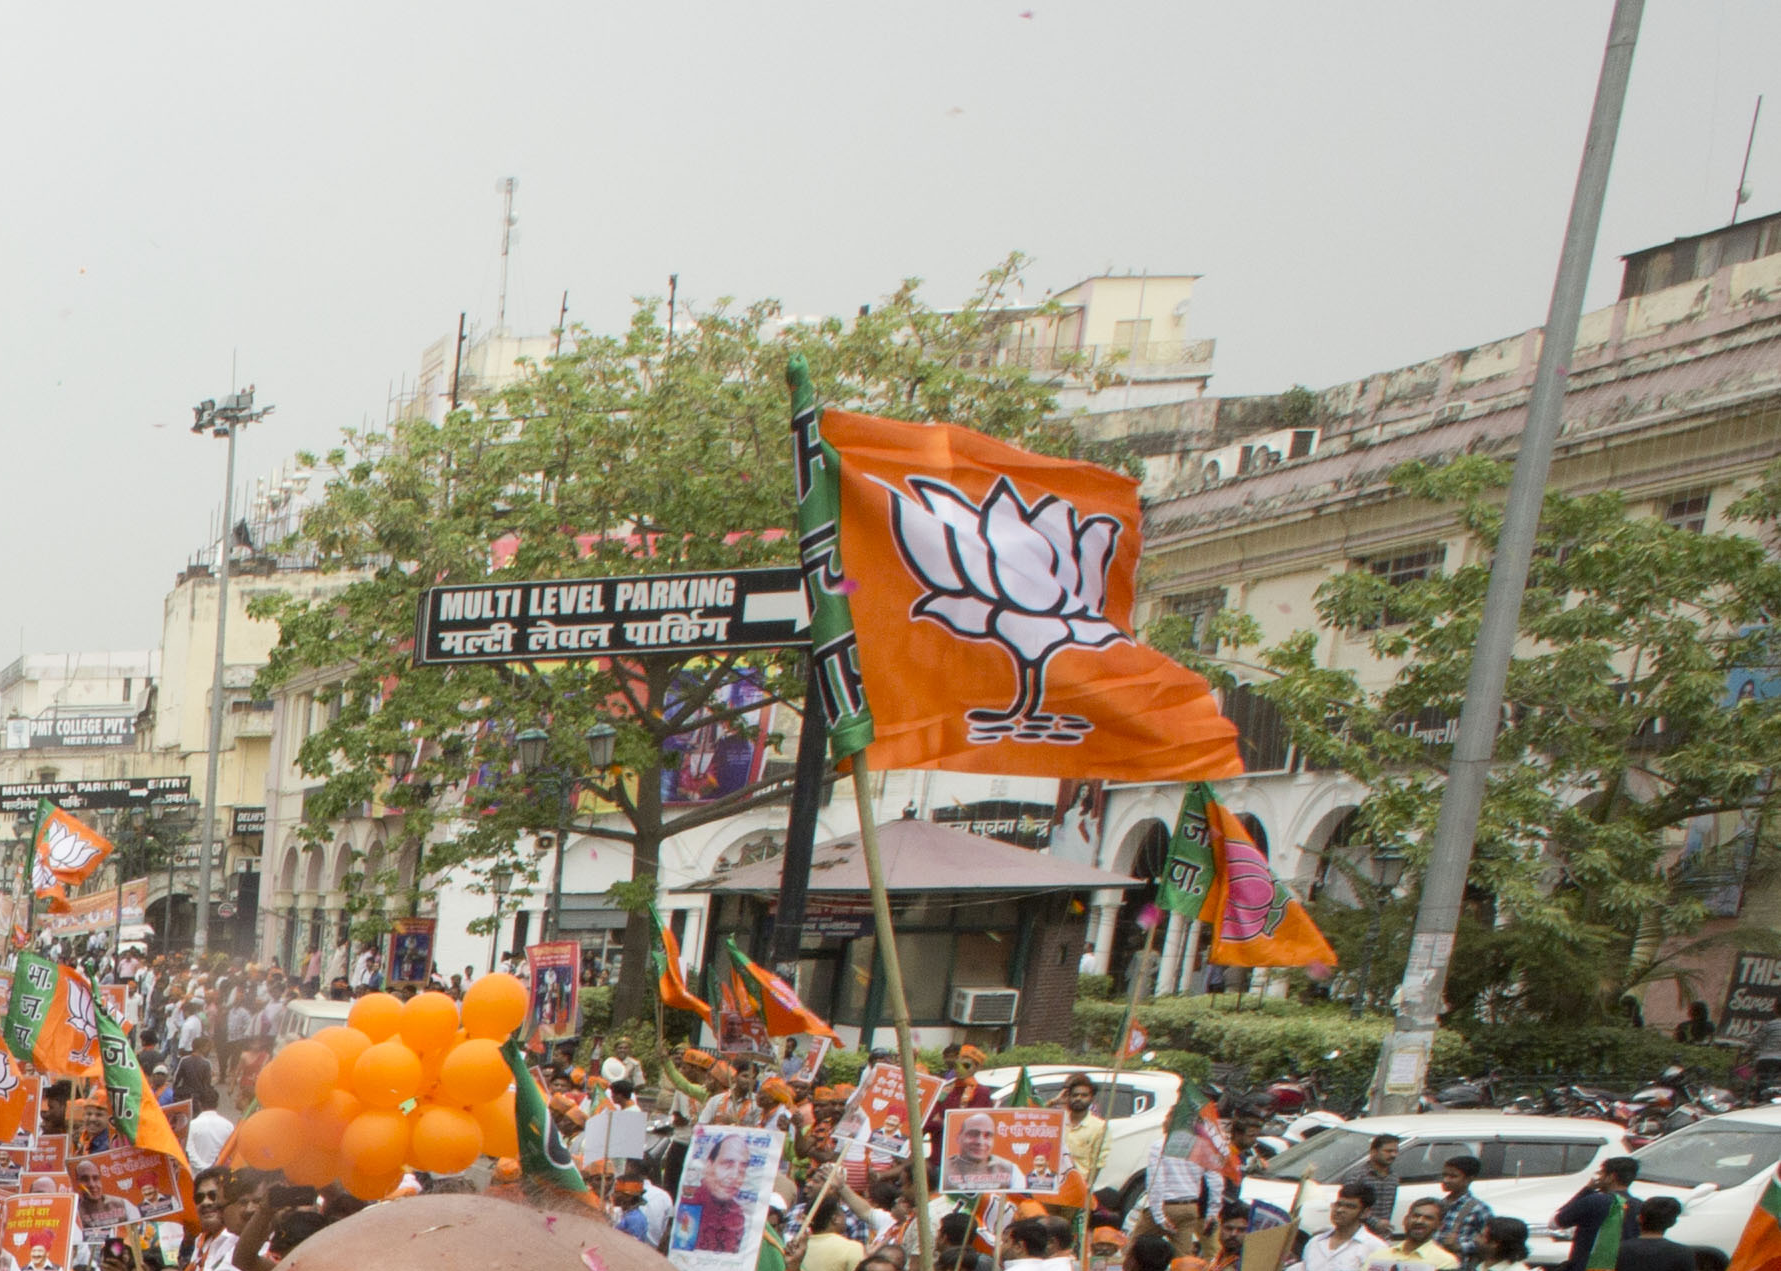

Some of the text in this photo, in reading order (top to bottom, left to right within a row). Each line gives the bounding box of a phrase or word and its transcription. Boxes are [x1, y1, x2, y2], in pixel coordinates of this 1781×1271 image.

[439, 577, 736, 621] MULTI LEVEL PARKING
[438, 621, 518, 655] मल्टी
[527, 620, 614, 651] लेवल
[56, 719, 101, 735] COLLEGE
[104, 718, 127, 734] PVT.
